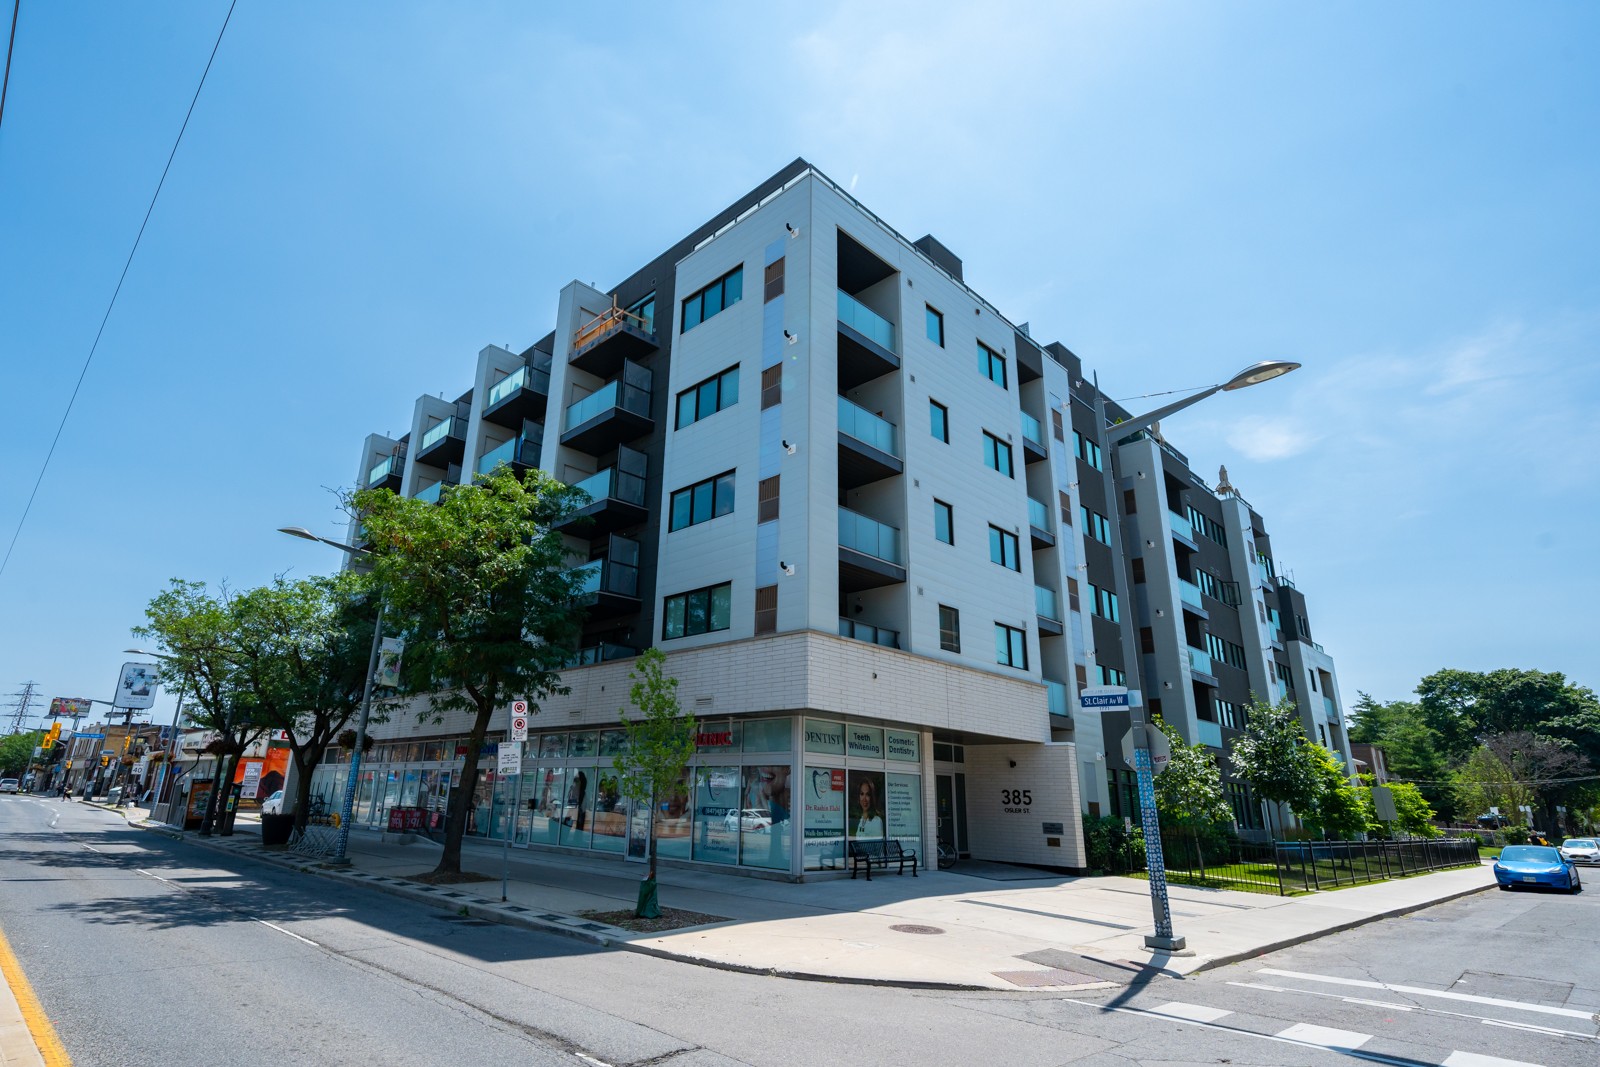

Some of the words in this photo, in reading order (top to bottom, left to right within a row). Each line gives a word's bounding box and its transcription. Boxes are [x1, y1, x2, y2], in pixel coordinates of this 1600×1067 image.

[1092, 696, 1108, 705] Clair
[1116, 696, 1123, 704] W
[805, 732, 840, 744] DENTIST
[853, 732, 871, 741] Teeth
[888, 736, 915, 746] Cosmetic
[849, 742, 880, 753] Whitening
[888, 746, 915, 757] Dentistry
[1001, 789, 1032, 806] 385
